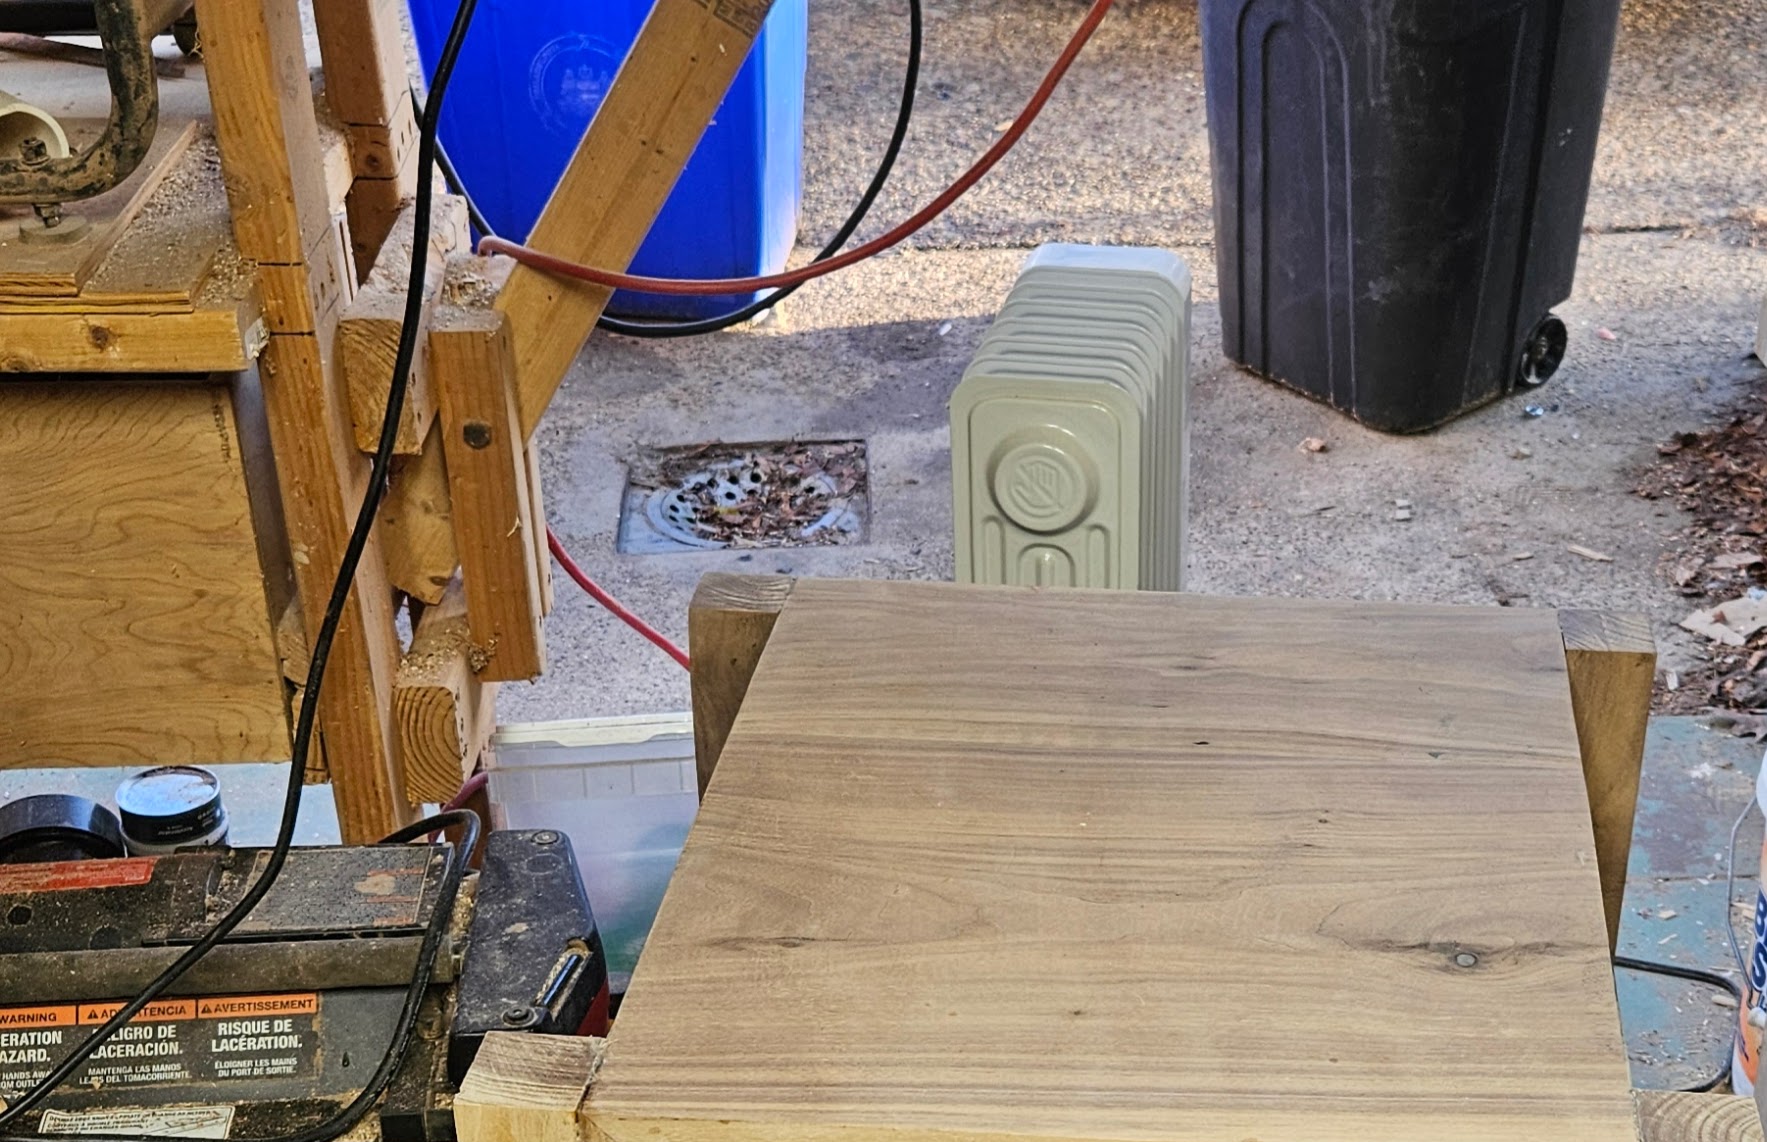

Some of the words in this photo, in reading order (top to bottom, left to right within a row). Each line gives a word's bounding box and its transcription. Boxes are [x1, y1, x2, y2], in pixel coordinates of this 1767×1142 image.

[101, 1006, 187, 1018] ADTENCIA
[214, 999, 314, 1013] AVERTISSEMENT
[0, 1013, 57, 1024] WARNING
[92, 1026, 153, 1042] LIGRO
[157, 1025, 177, 1039] DE
[218, 1020, 270, 1036] RISQUE
[274, 1019, 293, 1033] DE
[0, 1030, 62, 1047] ERATION
[211, 1035, 303, 1052] LACÉRATION.
[0, 1048, 51, 1064] AZARD.
[88, 1065, 133, 1076] MANTENGA
[135, 1064, 151, 1073] LAS
[152, 1063, 182, 1073] MANOS
[215, 1058, 254, 1069] ÉLOIGNER
[255, 1058, 270, 1067] LES
[271, 1057, 298, 1066] MAINS
[2, 1071, 31, 1081] HANDS
[218, 1069, 230, 1077] DU
[231, 1068, 251, 1076] PORT
[253, 1067, 265, 1075] DE
[79, 1075, 104, 1085] LES
[106, 1074, 122, 1083] DEL
